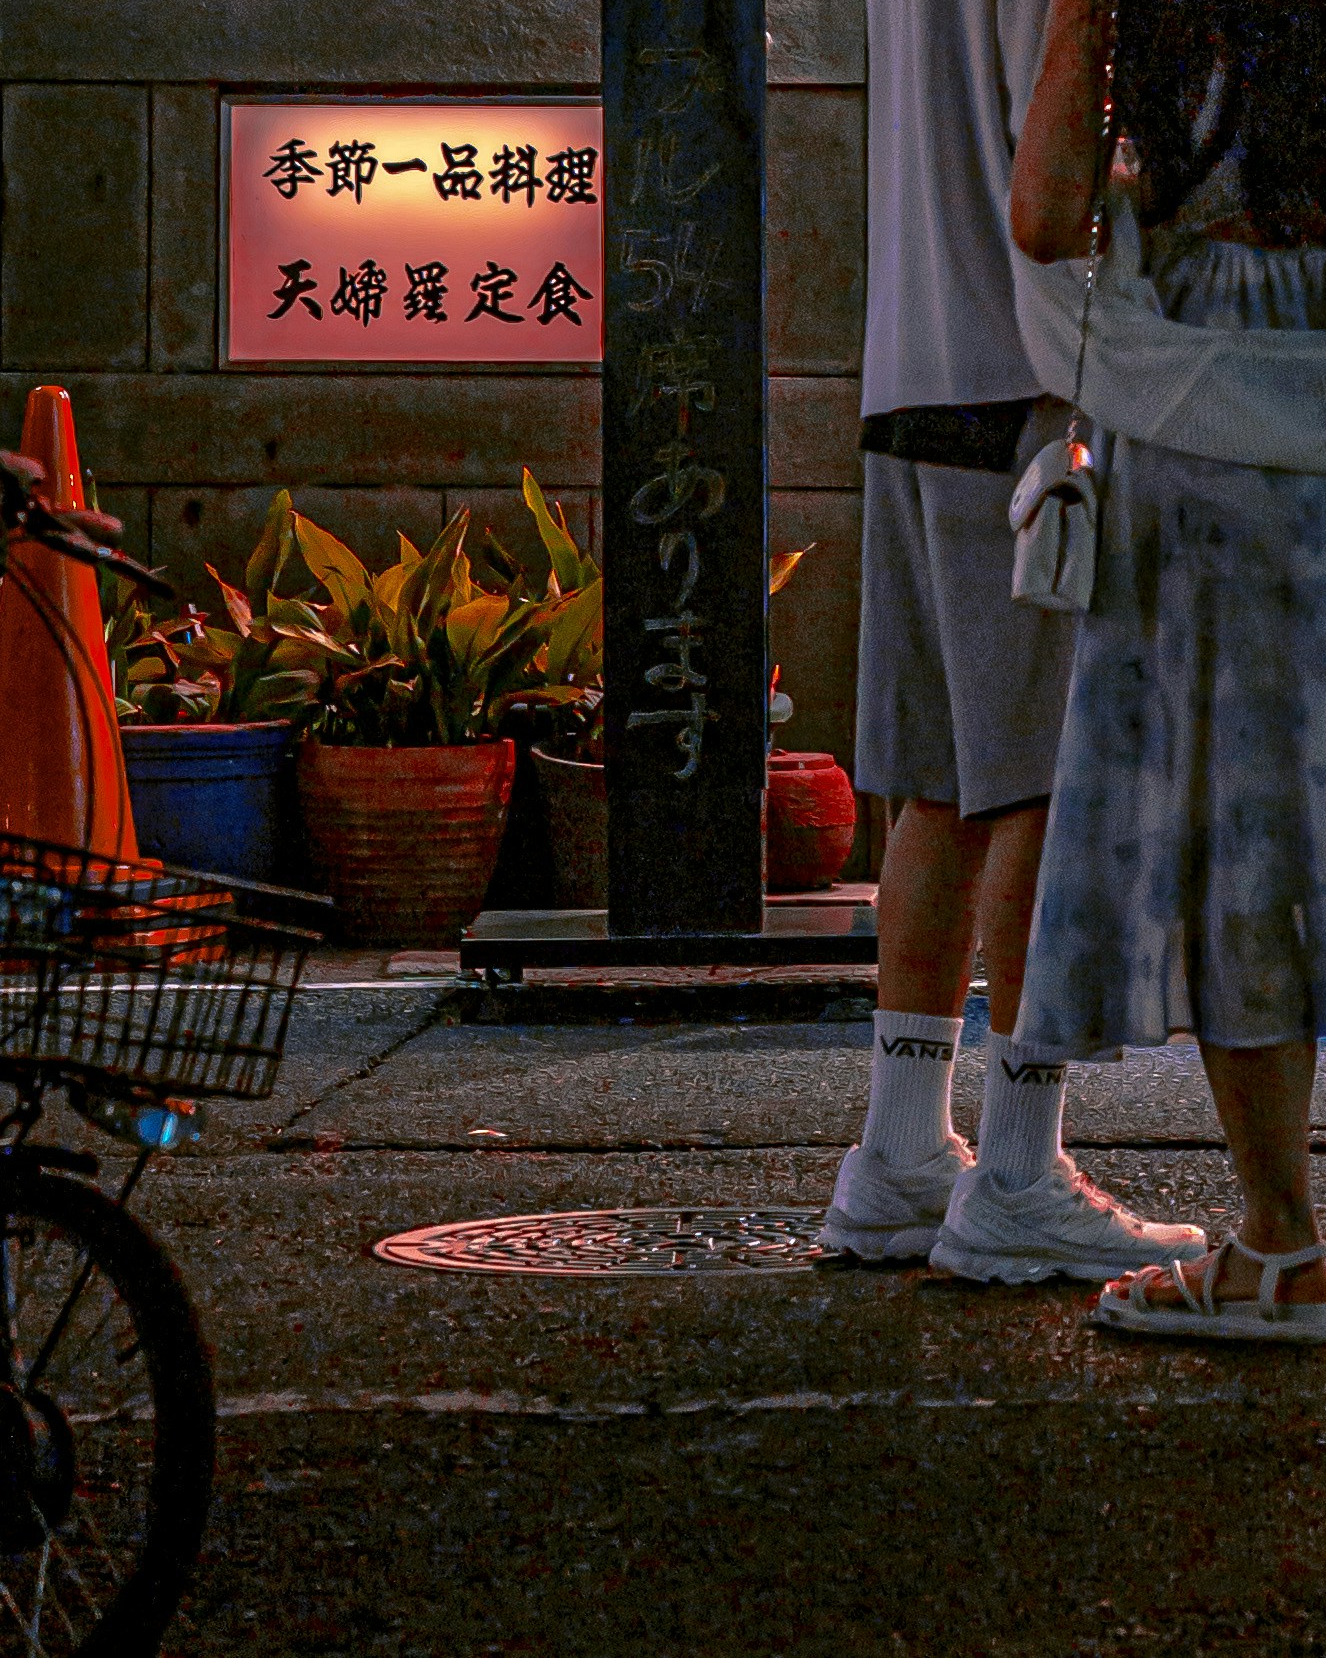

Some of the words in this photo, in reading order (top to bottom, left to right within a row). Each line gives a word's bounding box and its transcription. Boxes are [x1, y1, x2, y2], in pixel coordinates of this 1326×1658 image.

[262, 138, 600, 209] 季節一品料理
[266, 258, 596, 329] 天婦羅定食
